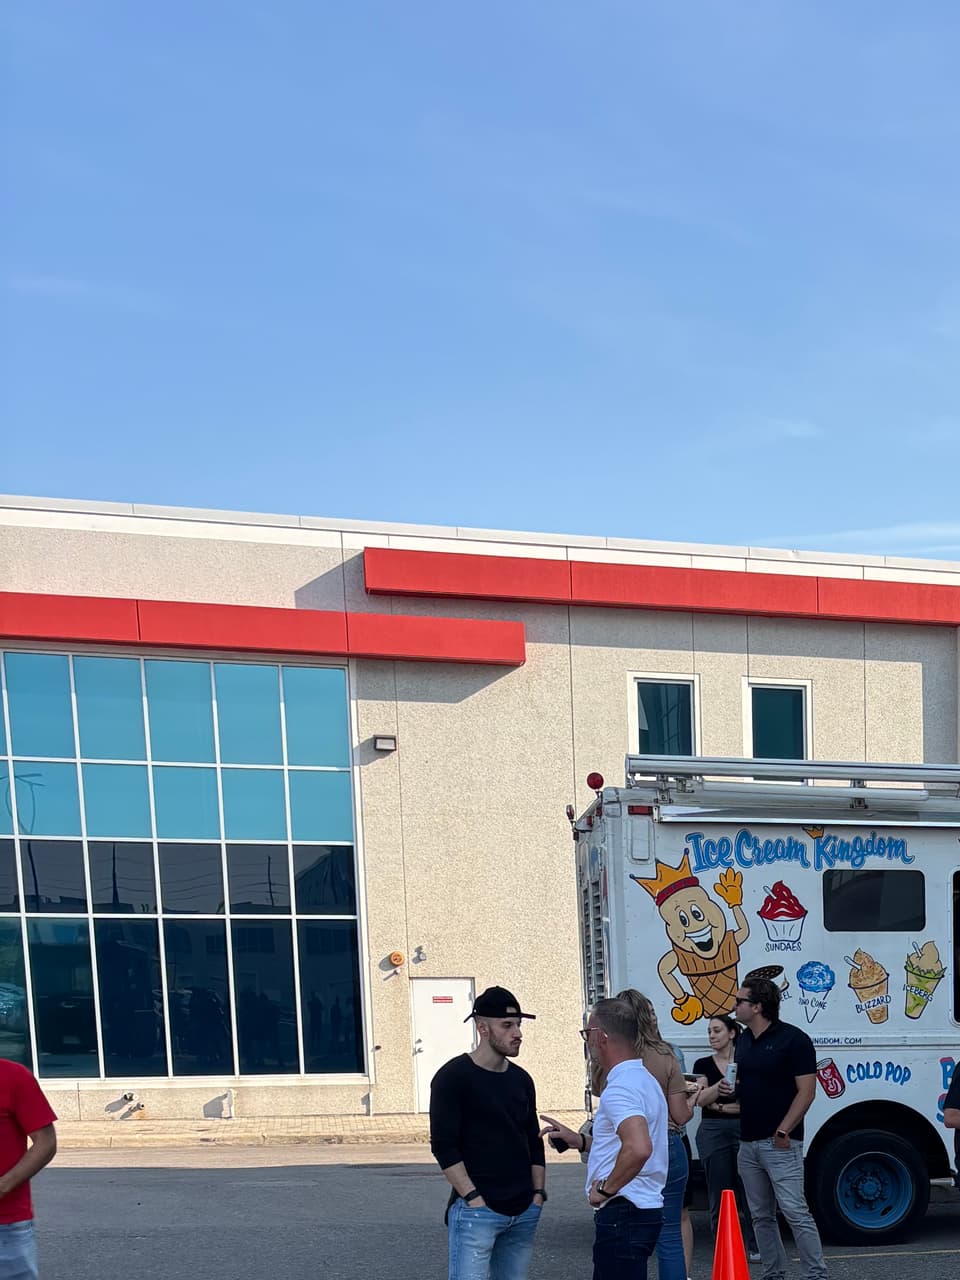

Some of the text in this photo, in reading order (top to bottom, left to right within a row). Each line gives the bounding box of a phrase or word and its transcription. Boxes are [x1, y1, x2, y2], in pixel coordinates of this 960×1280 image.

[685, 828, 916, 875] Ice Cream Kingdom
[765, 942, 802, 952] SUNDAES
[902, 984, 934, 1002] ICEBERG
[855, 994, 892, 1014] BLIZZARD
[846, 1061, 883, 1083] COLD
[885, 1061, 912, 1086] POP
